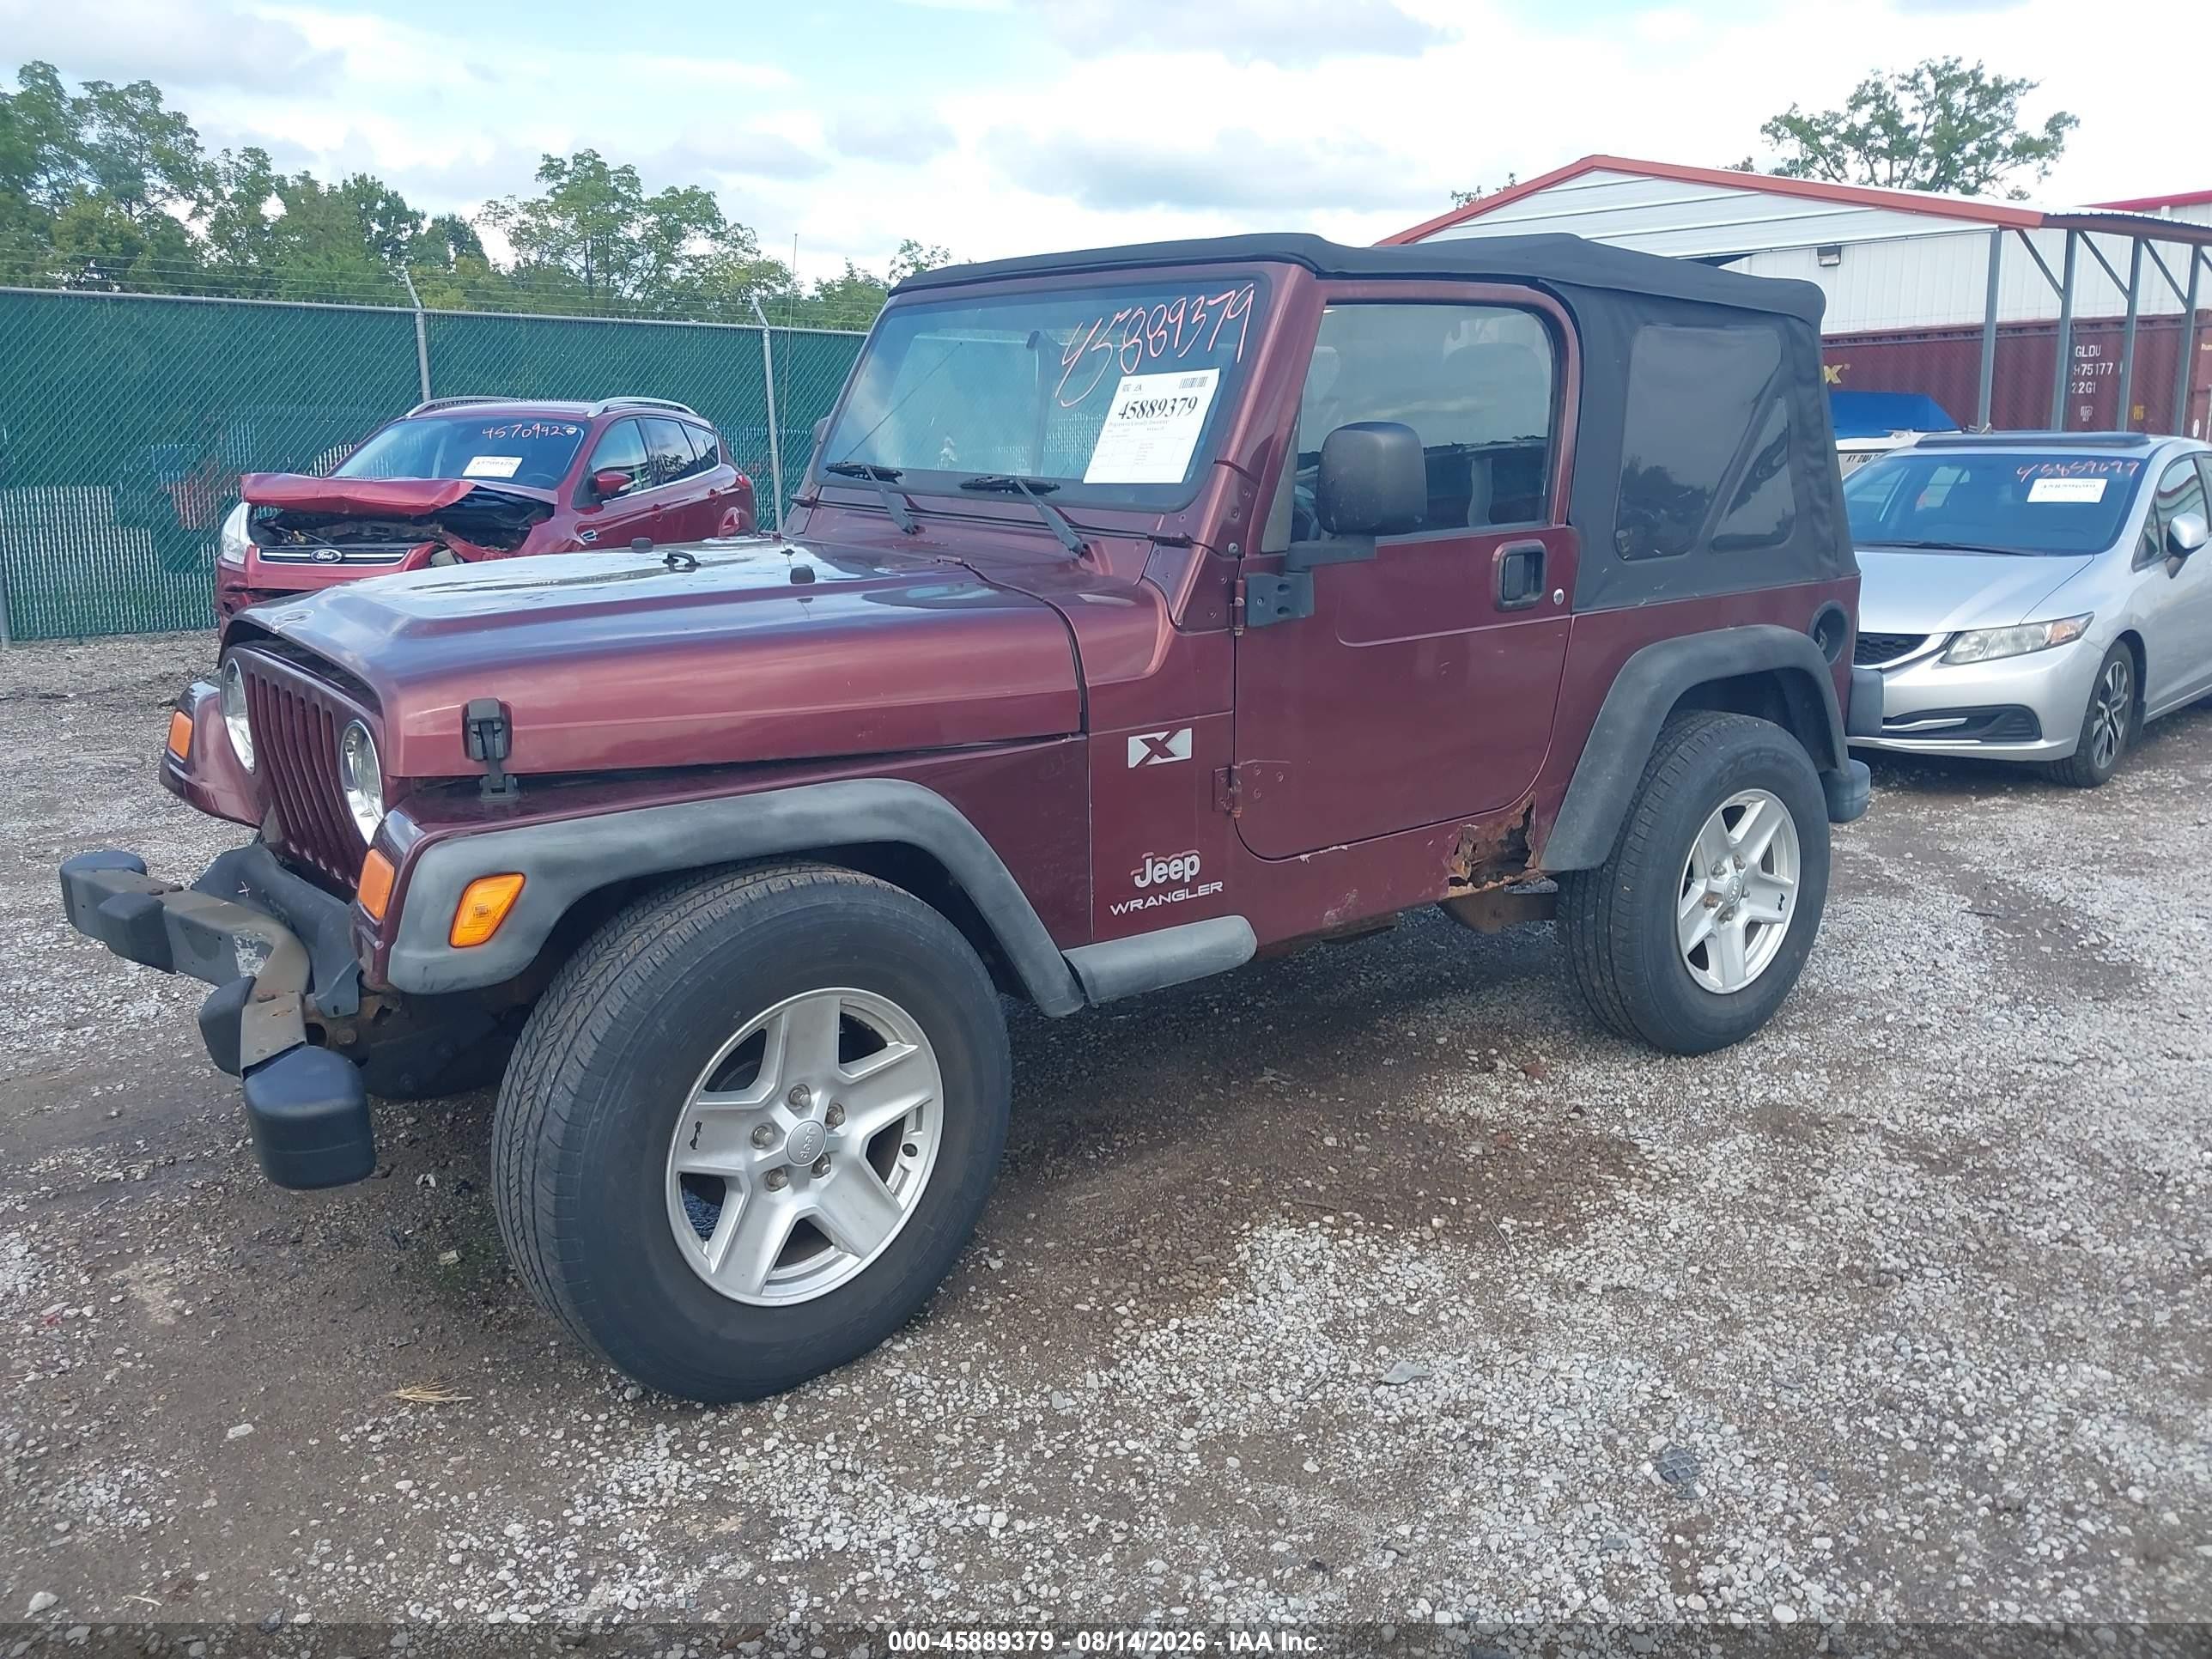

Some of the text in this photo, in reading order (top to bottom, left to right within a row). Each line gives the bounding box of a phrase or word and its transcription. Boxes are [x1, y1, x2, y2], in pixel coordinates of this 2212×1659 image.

[1054, 283, 1255, 407] 45889379
[2075, 344, 2101, 357] GLDU
[1118, 396, 1198, 420] 45889379
[1132, 851, 1200, 888] Jeep
[1110, 881, 1224, 915] WRANGLER
[799, 1126, 817, 1159] Jeep
